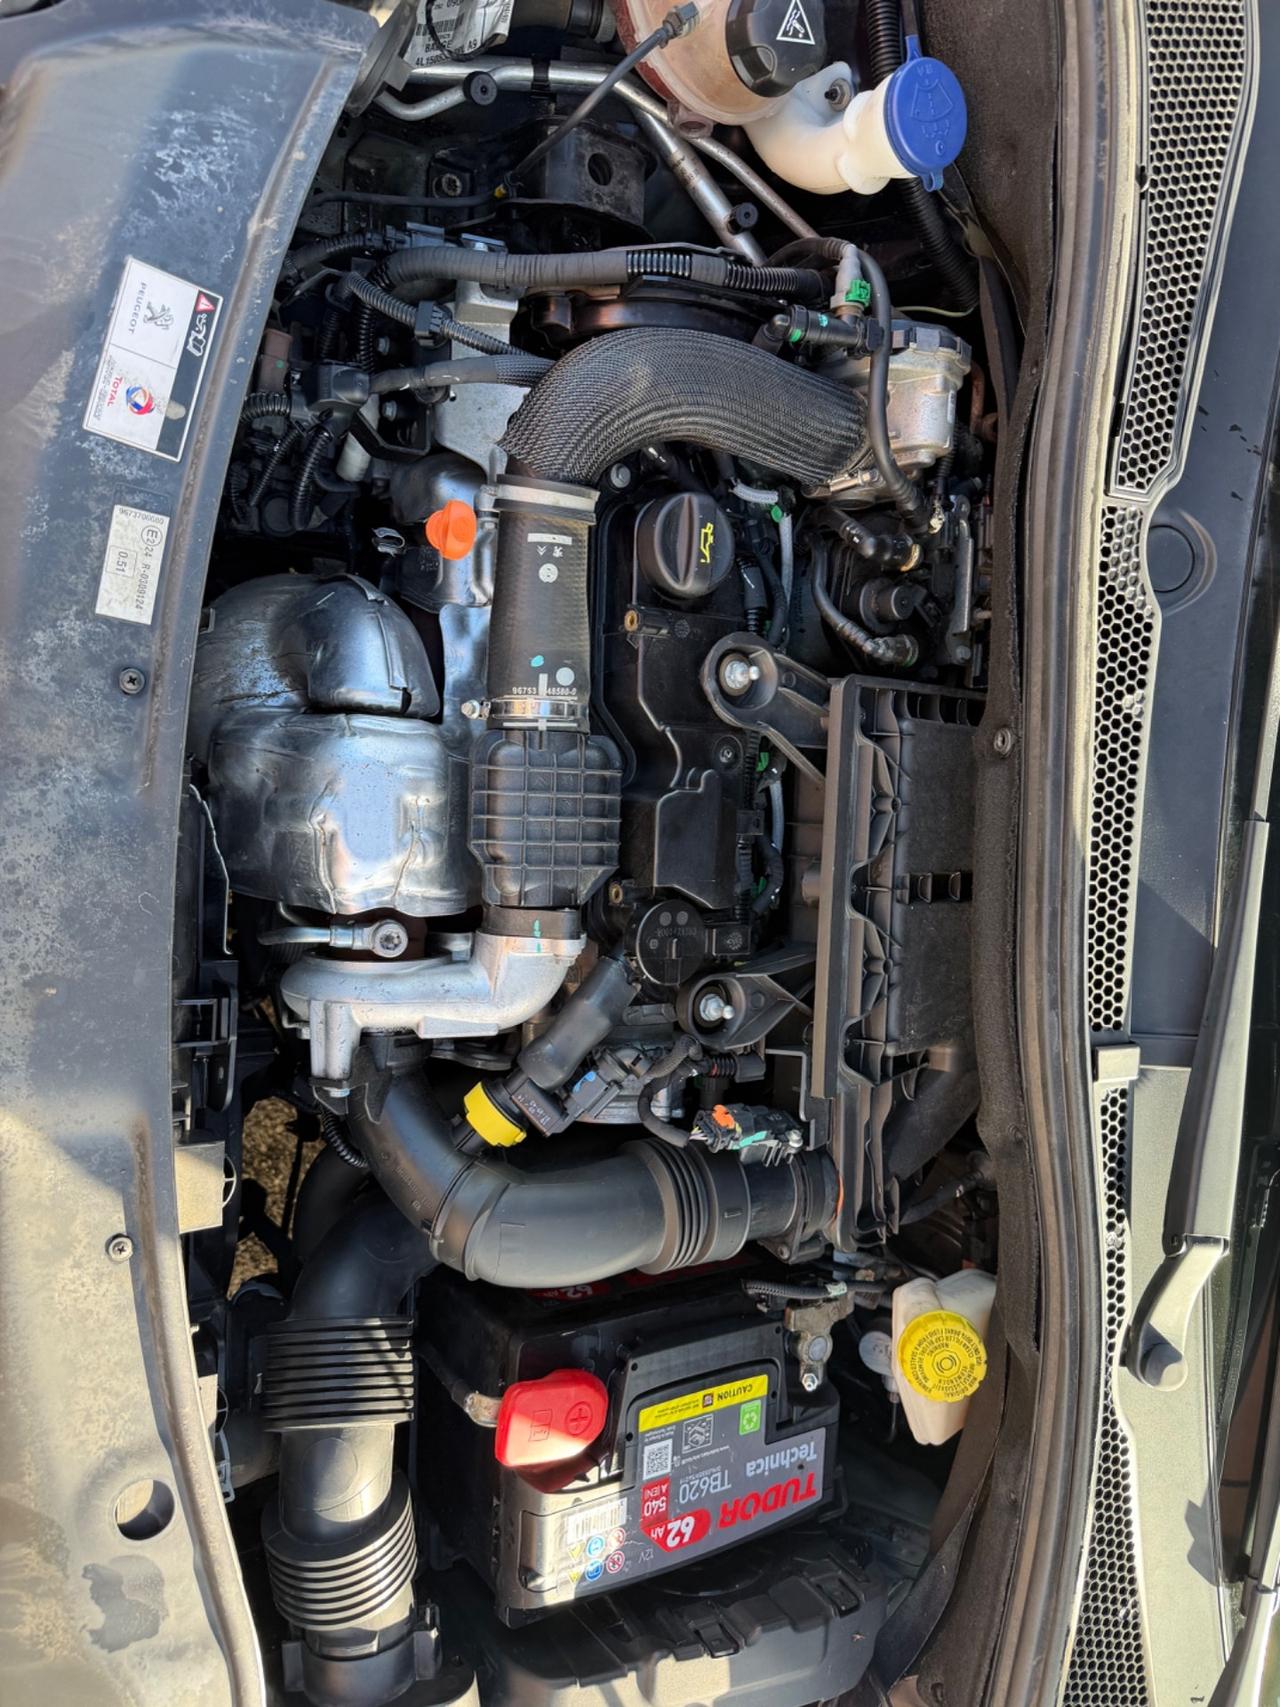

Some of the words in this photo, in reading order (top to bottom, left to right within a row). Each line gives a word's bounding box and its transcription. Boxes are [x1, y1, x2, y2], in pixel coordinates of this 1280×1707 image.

[128, 282, 147, 334] PEUGEOT
[107, 376, 123, 407] TOTAL
[116, 551, 128, 572] 0.51
[717, 1384, 752, 1400] CAUTION
[746, 1441, 817, 1478] Technica
[680, 1470, 732, 1504] TB620
[718, 1472, 817, 1529] TUDOR
[644, 1496, 666, 1516] 540
[650, 1525, 666, 1540] Ah
[666, 1516, 695, 1548] 62
